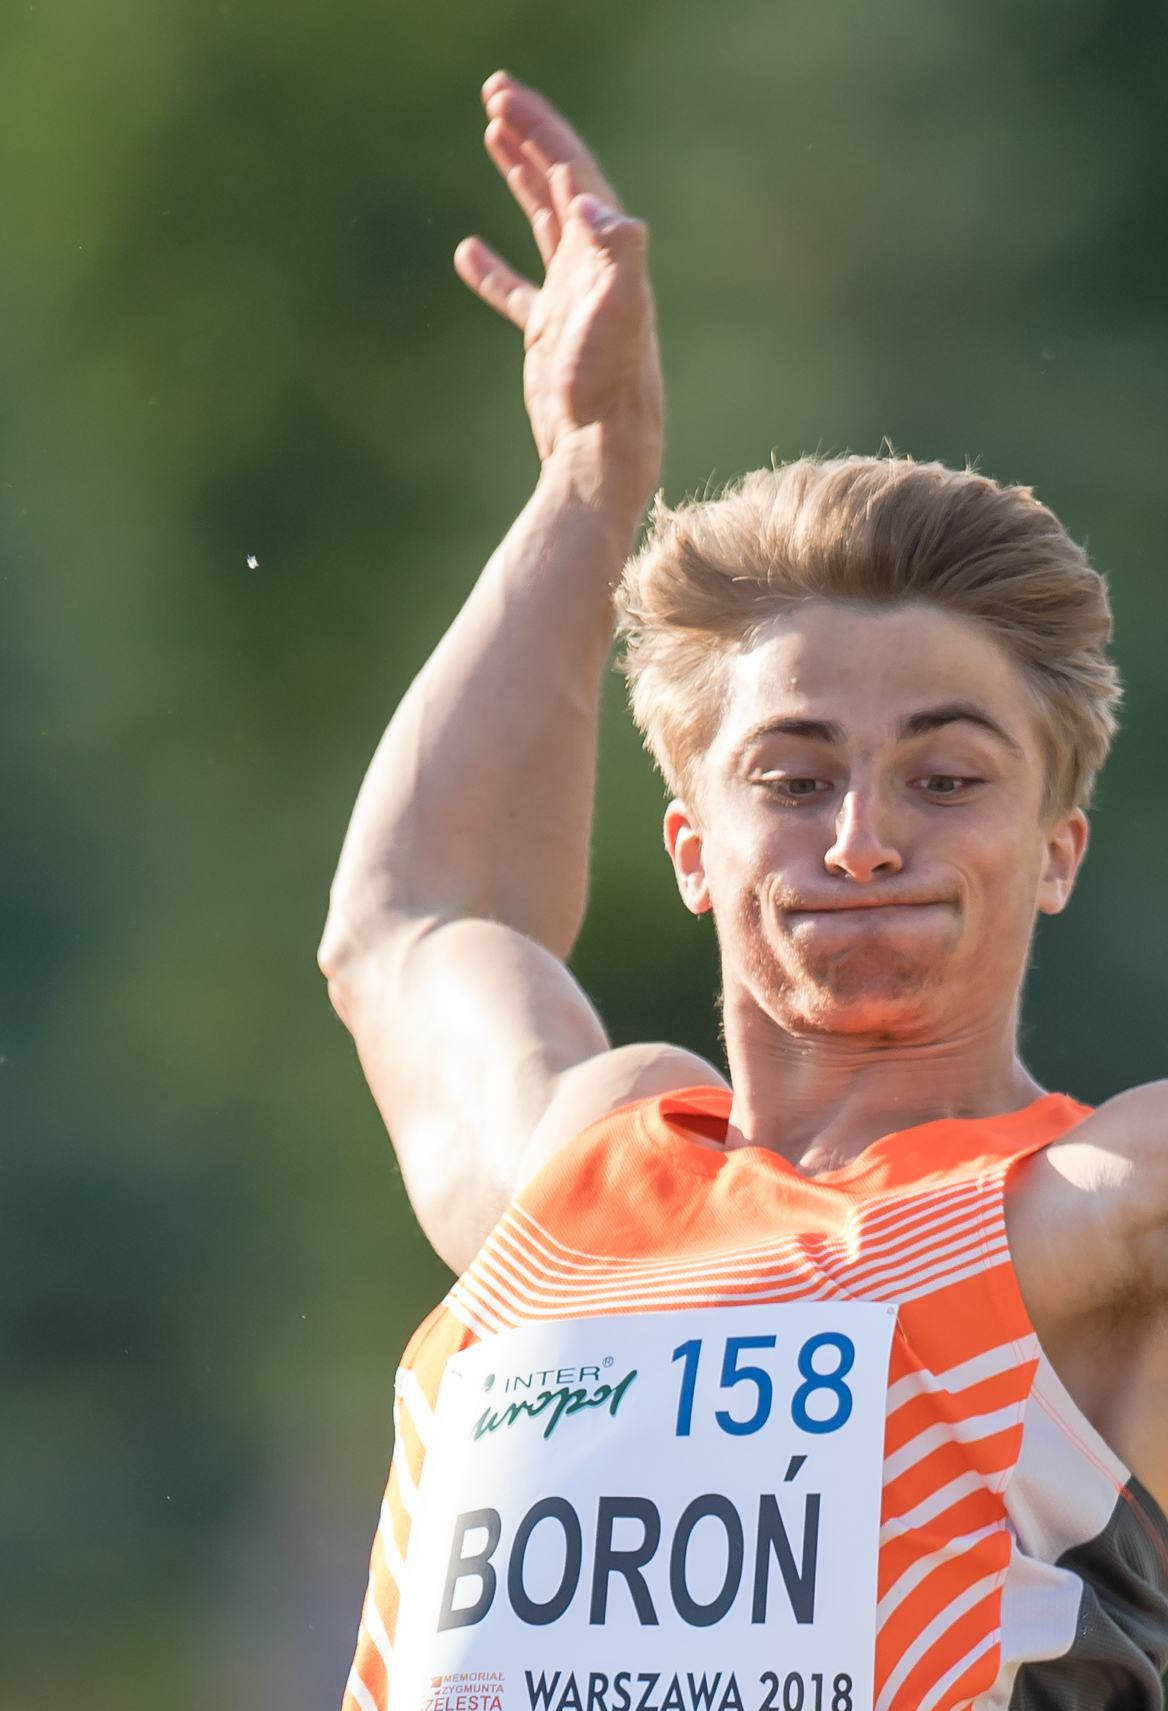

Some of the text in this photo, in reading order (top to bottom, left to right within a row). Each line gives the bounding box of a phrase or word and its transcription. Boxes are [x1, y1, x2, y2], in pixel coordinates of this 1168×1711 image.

[671, 1331, 856, 1437] 158
[437, 1455, 822, 1632] BOROŃ
[441, 1684, 505, 1695] ZYGMUNTA
